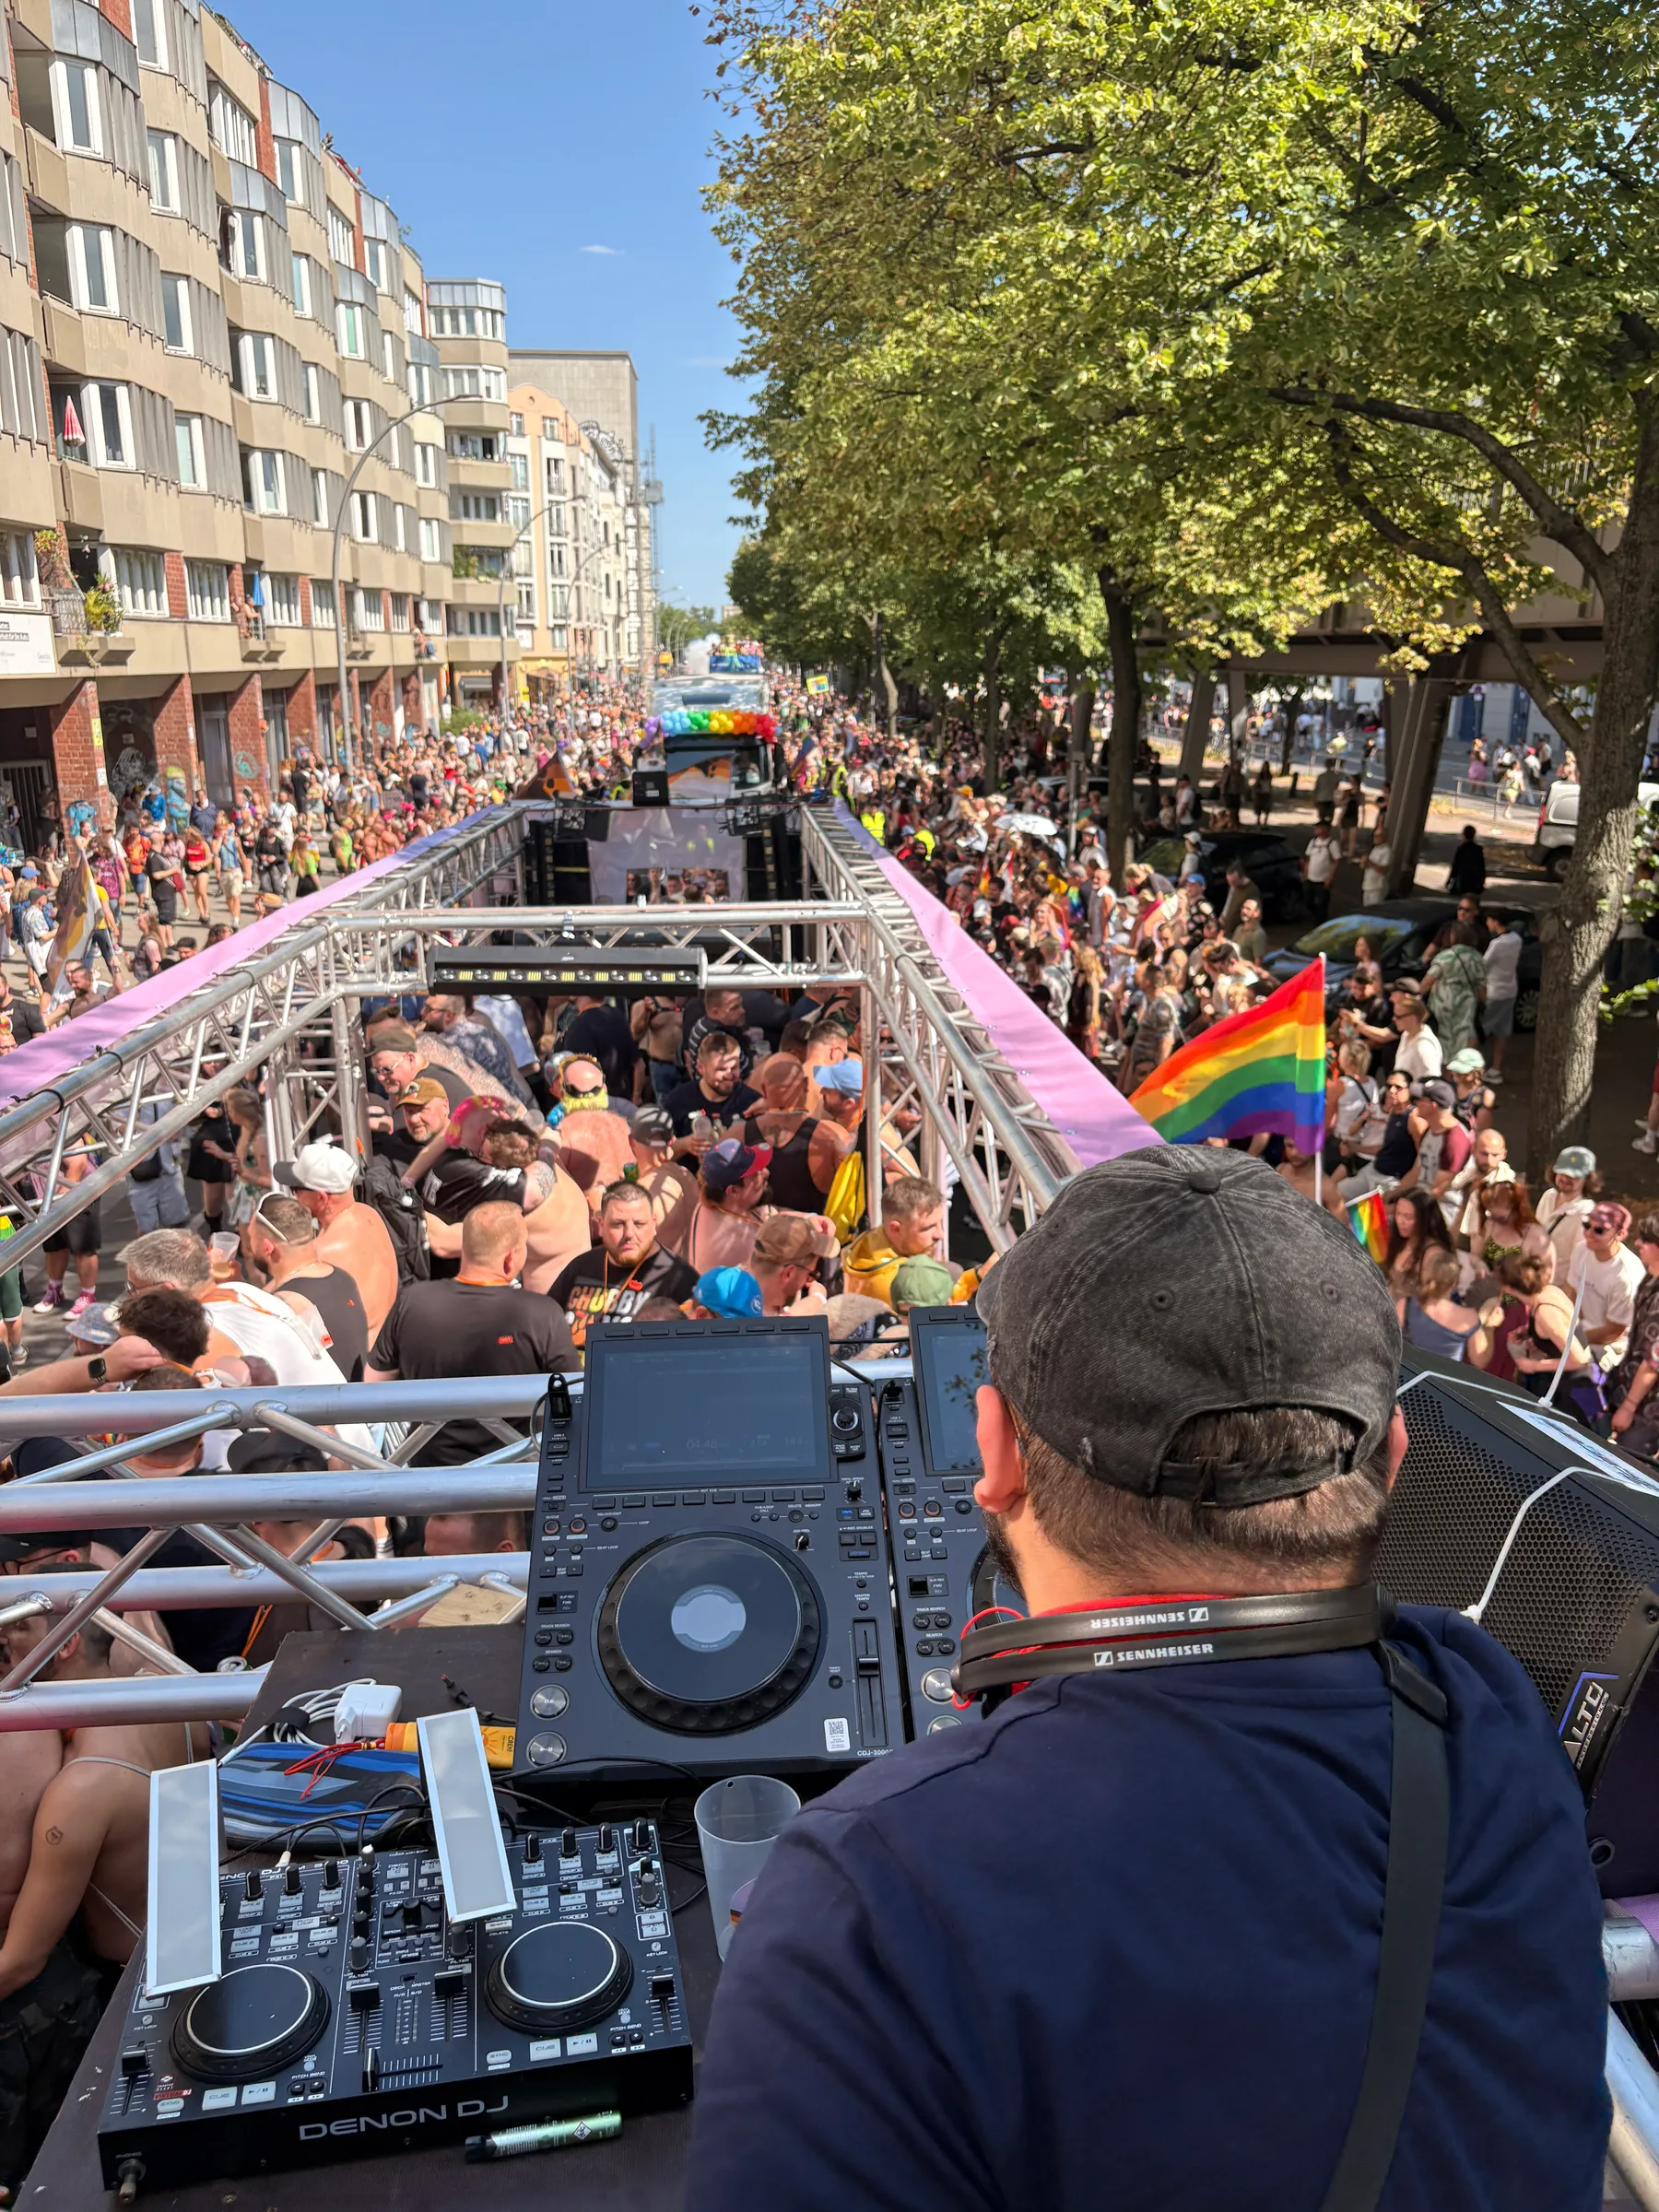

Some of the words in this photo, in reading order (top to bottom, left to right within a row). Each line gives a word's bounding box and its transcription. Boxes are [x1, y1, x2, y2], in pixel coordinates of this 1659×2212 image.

[567, 1286, 652, 1316] CHUBBY
[1090, 1611, 1185, 1630] SENNHEISER
[1116, 1643, 1214, 1663] SENNHEISER
[299, 2104, 447, 2141] DENON
[457, 2095, 509, 2118] DJ
